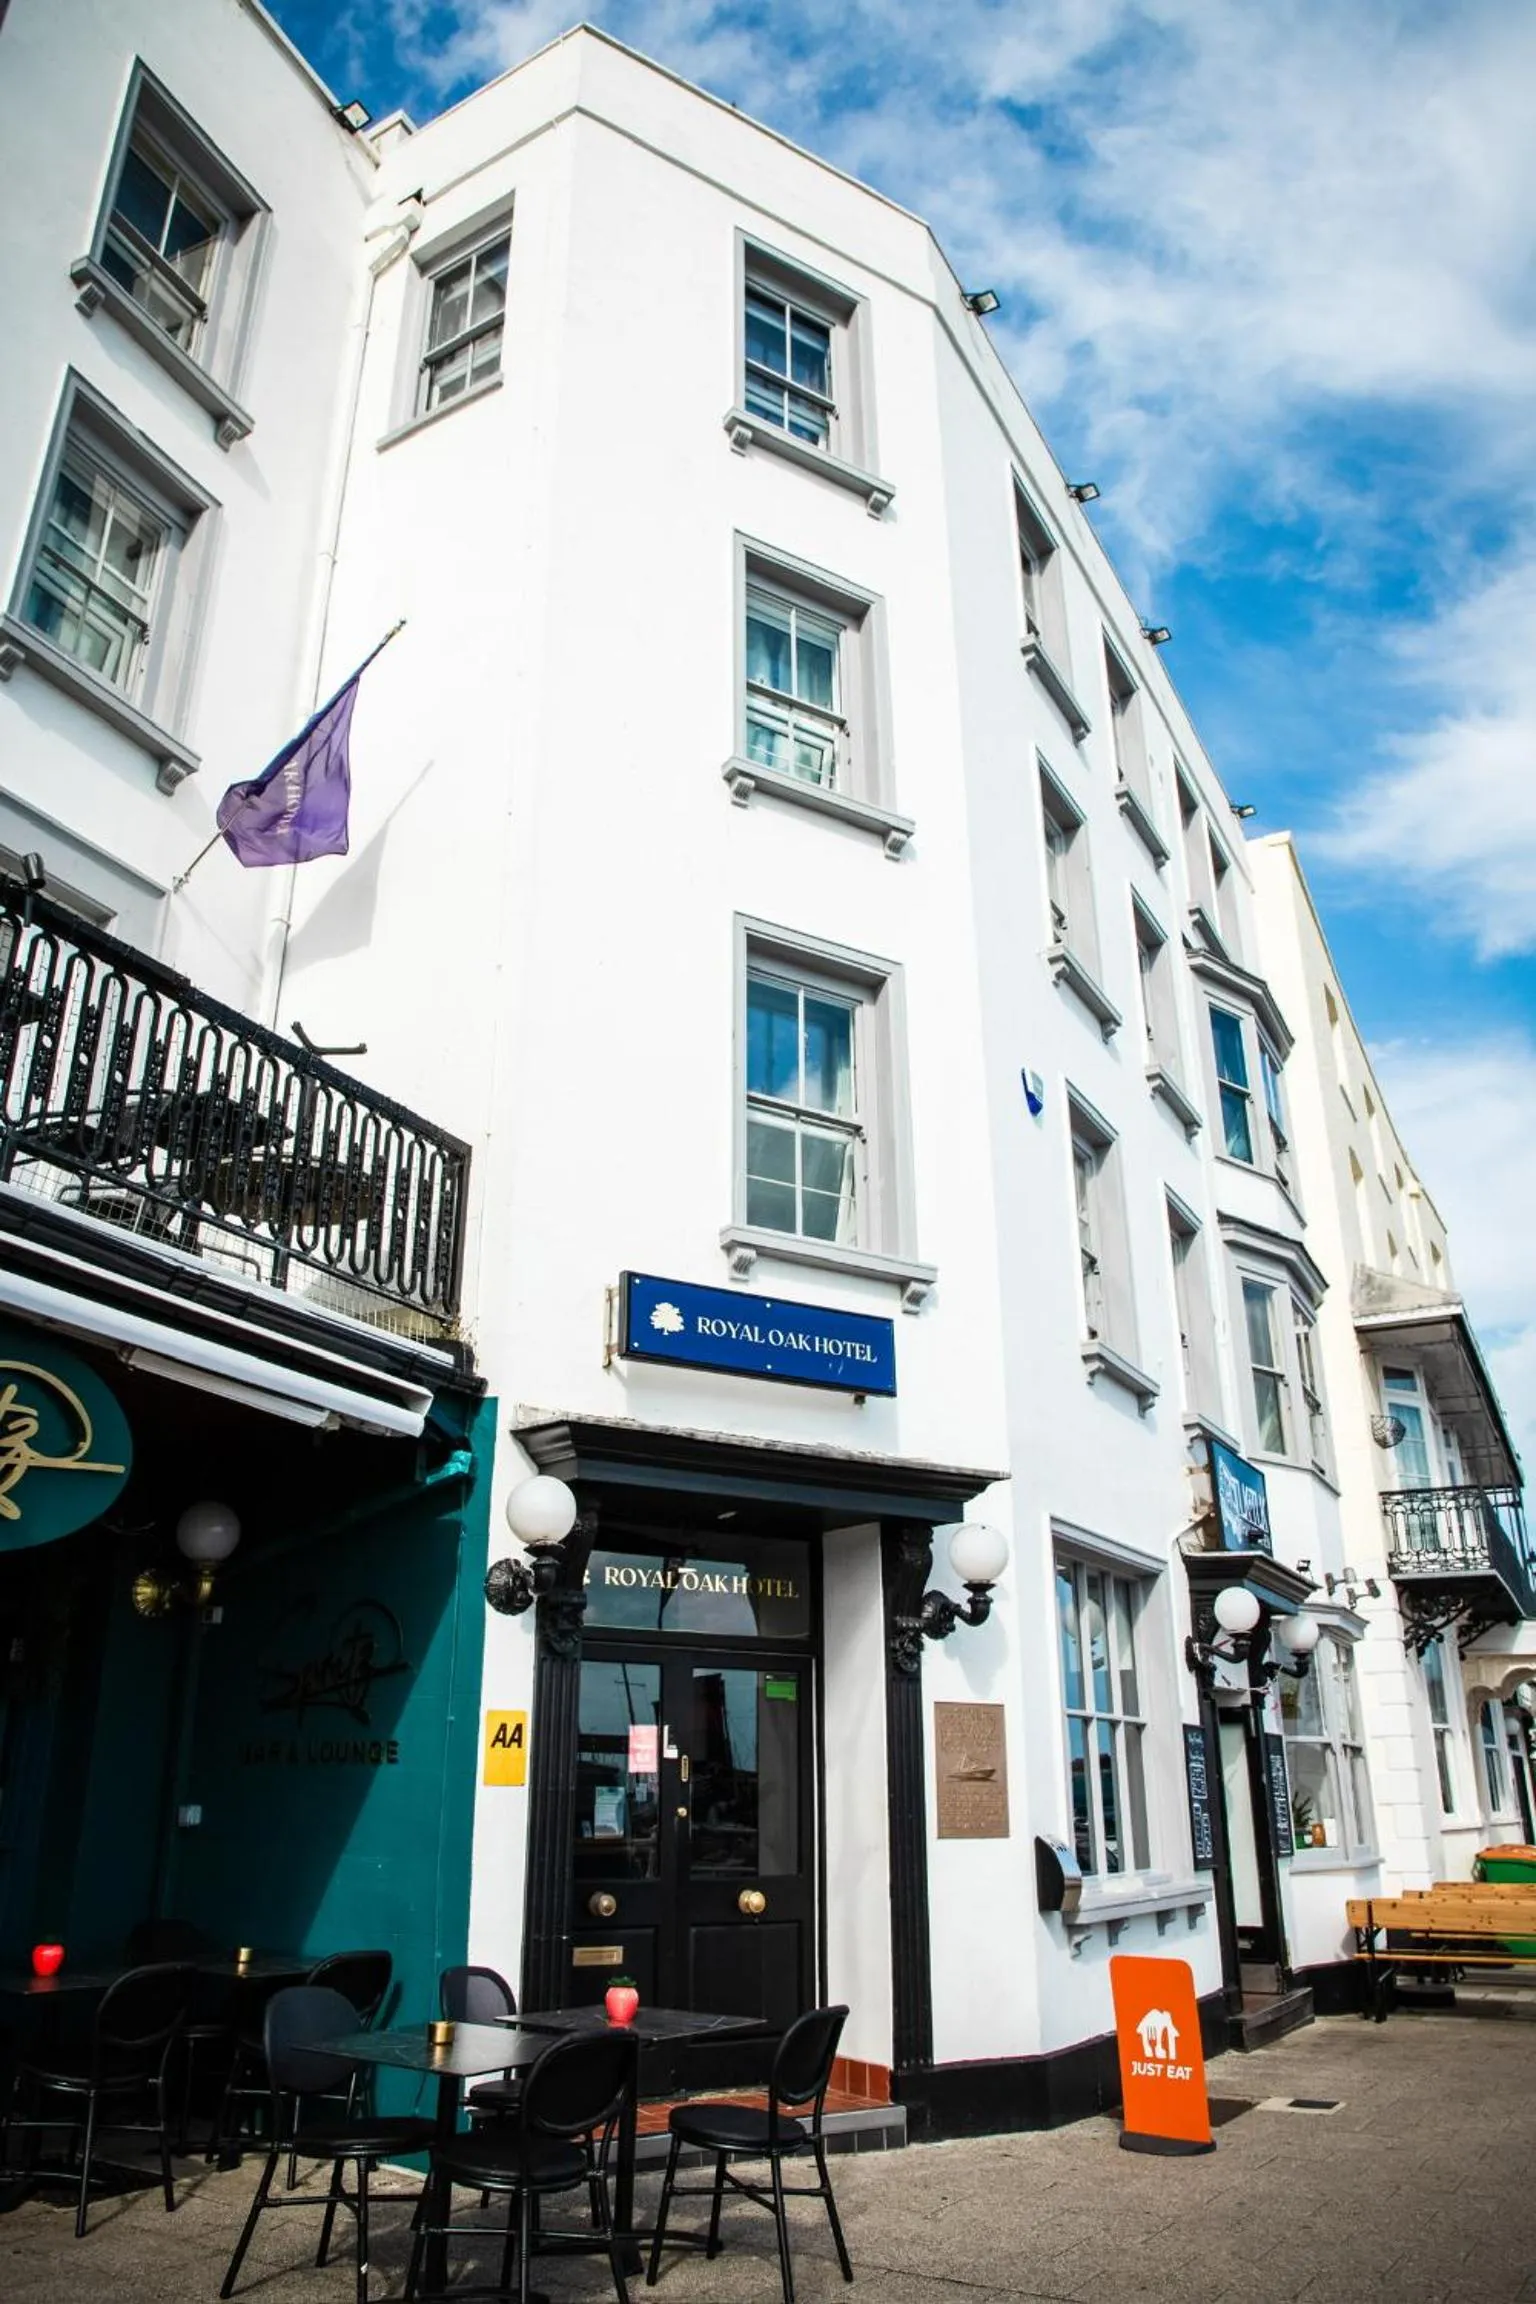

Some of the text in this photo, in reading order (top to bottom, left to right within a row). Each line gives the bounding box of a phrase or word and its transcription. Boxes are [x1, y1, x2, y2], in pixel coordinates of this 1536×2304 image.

[697, 1316, 877, 1364] ROYAL OAK HOTEL
[605, 1566, 799, 1599] ROYAL OAK HOTEL
[490, 1723, 523, 1749] AA
[307, 1740, 399, 1764] LOUNGE
[1131, 2061, 1193, 2080] JUST EAT
